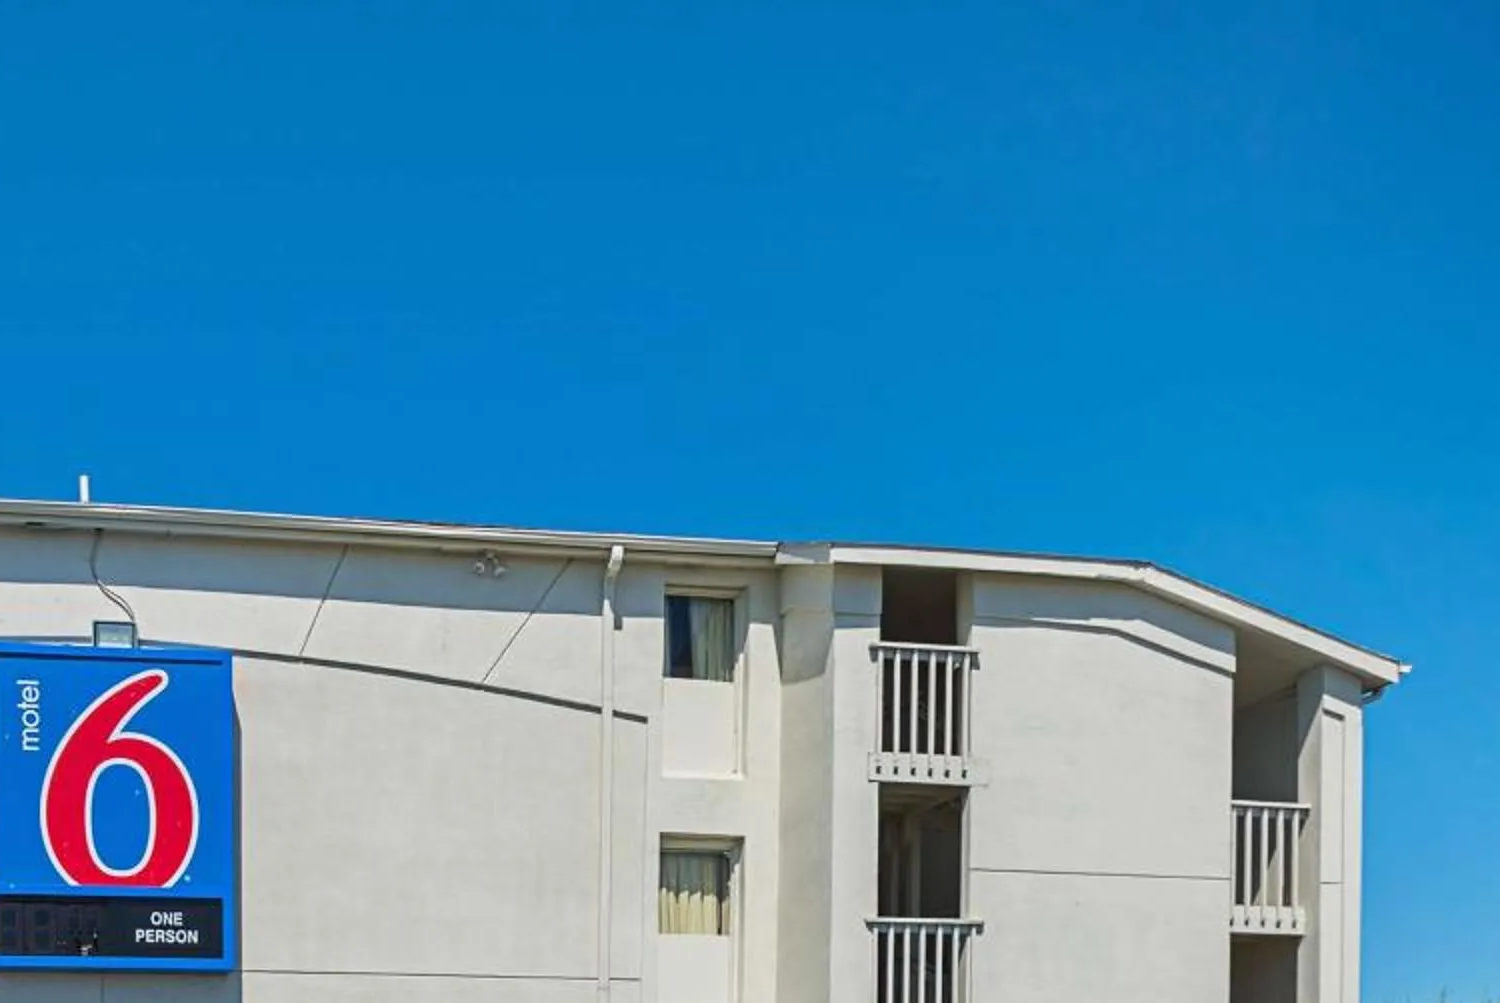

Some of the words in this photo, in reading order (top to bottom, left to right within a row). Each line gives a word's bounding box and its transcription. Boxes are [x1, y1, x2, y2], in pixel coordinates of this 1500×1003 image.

[15, 679, 40, 751] motel
[39, 669, 199, 887] 6
[135, 928, 199, 944] PERSON
[150, 911, 183, 926] ONE
